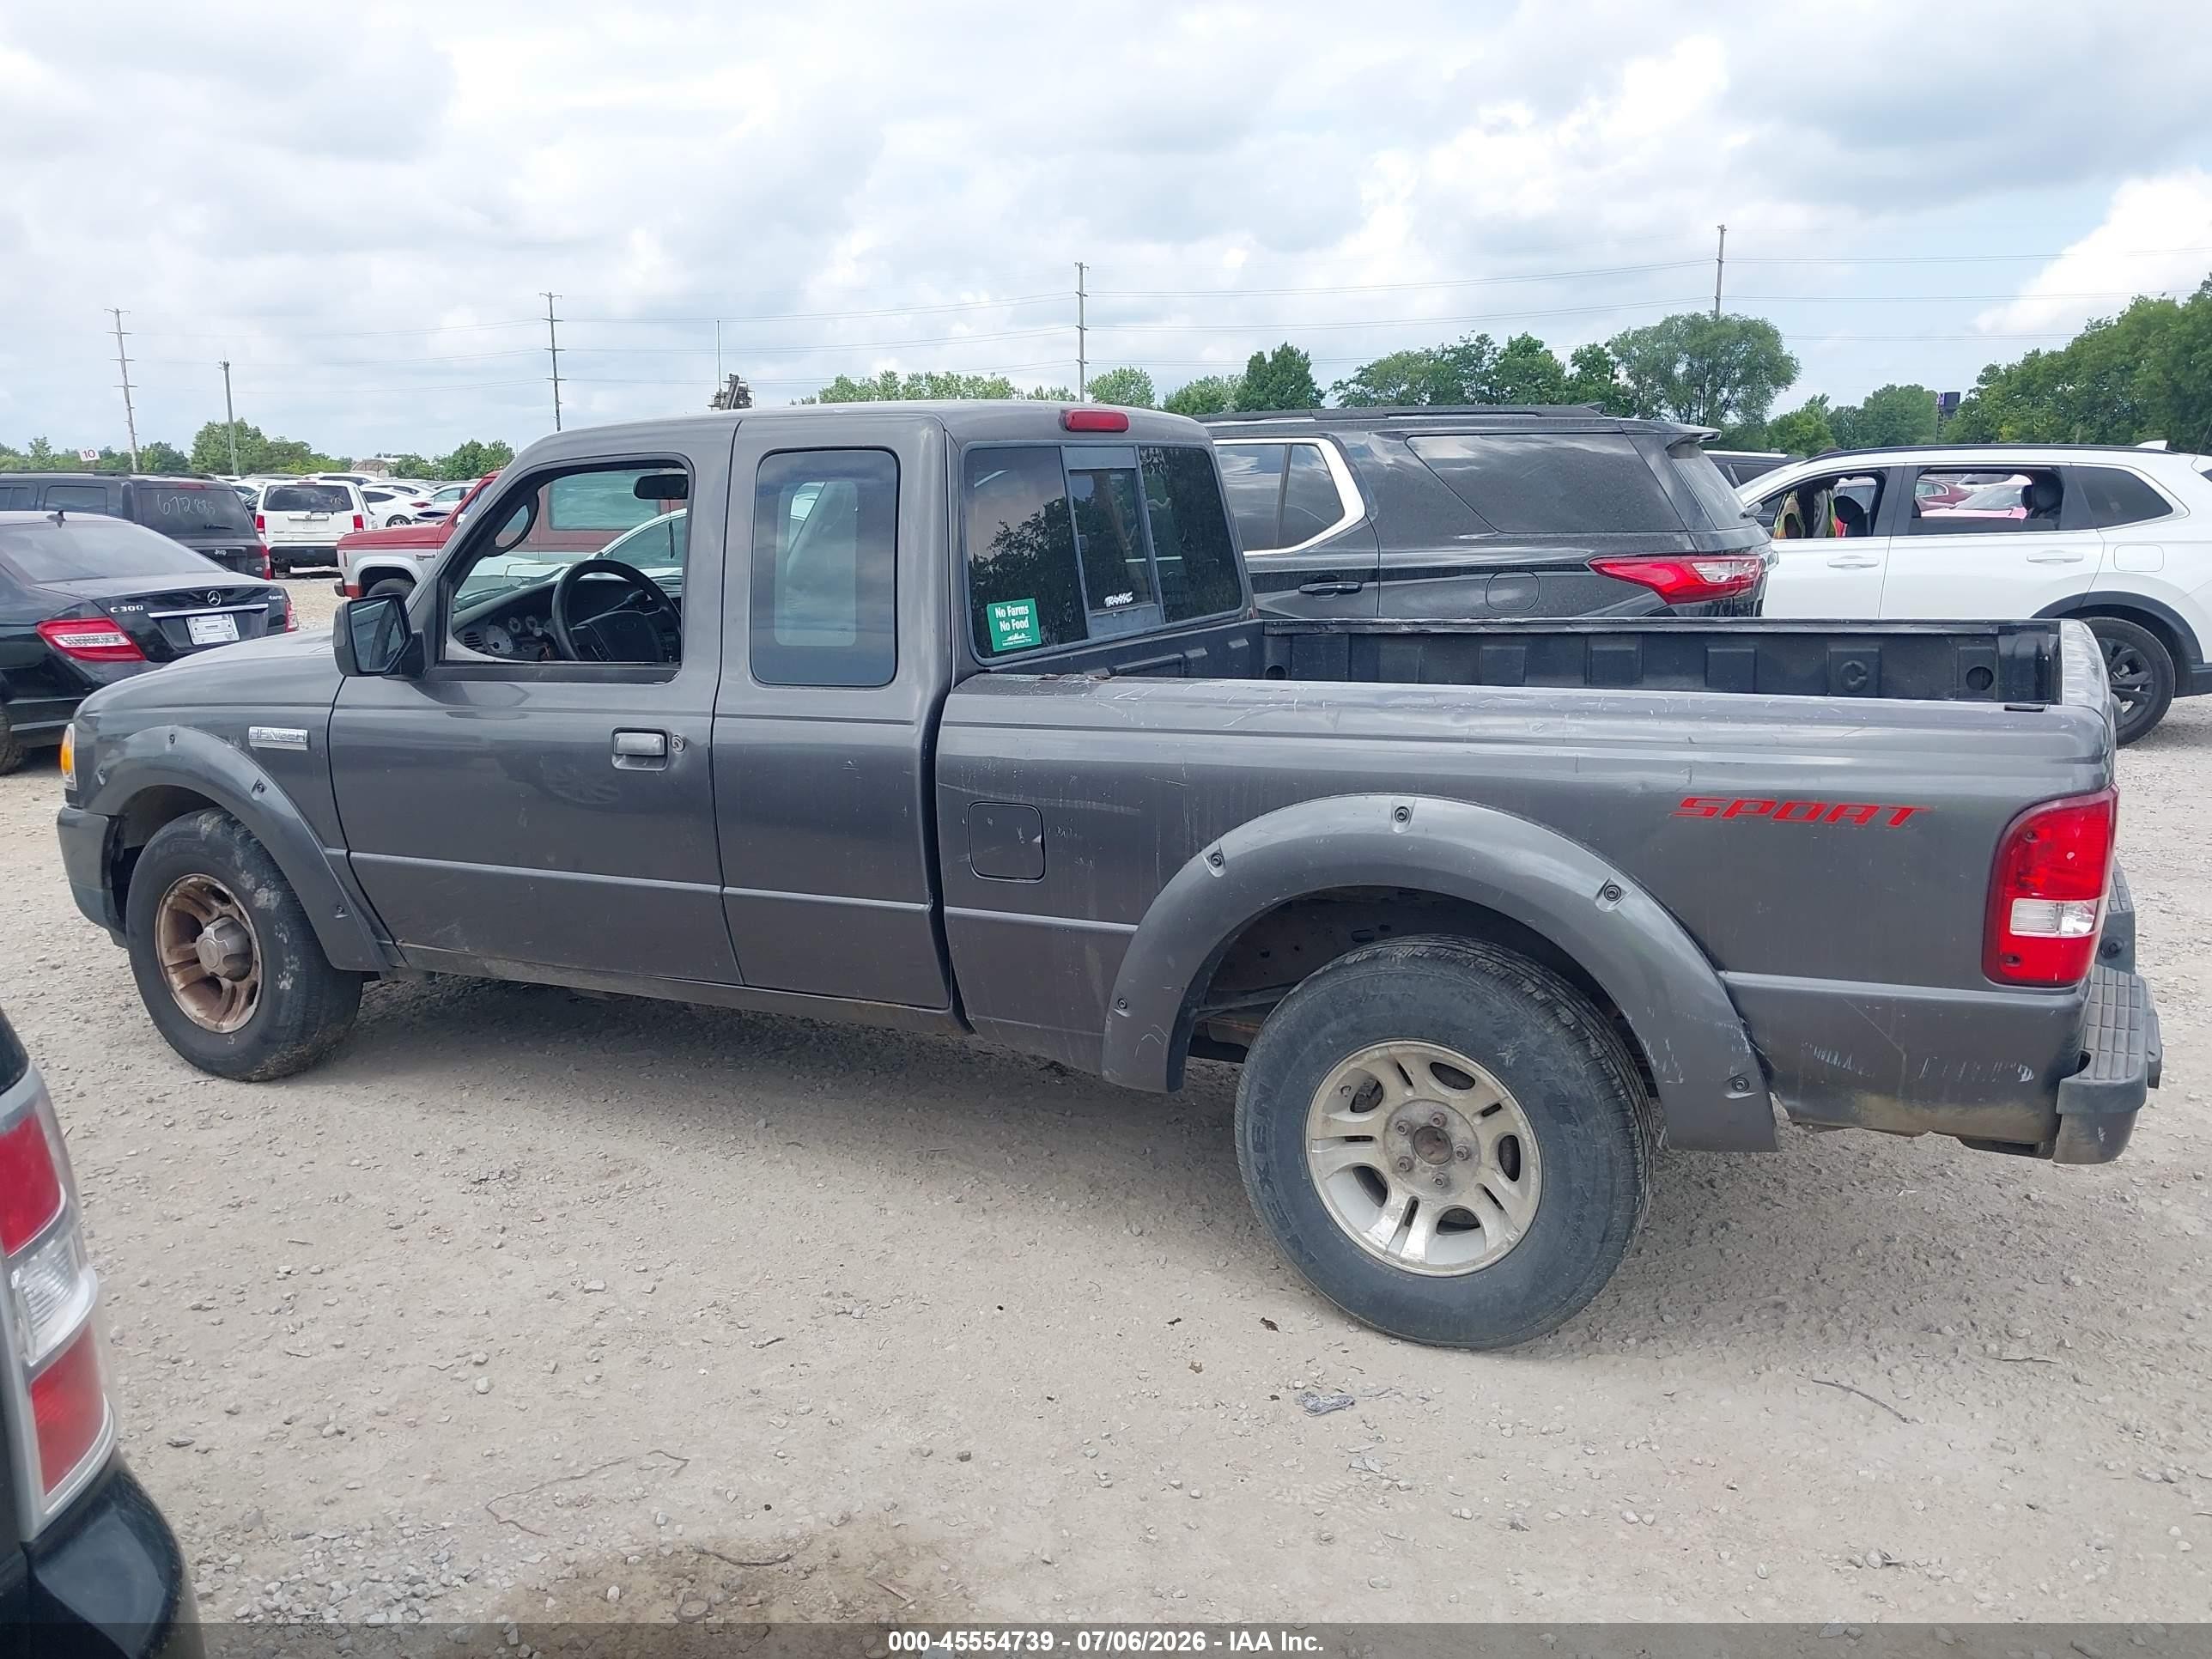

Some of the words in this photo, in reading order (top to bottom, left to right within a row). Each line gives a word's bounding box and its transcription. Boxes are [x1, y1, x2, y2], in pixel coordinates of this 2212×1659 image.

[82, 449, 96, 459] 10
[994, 606, 1006, 618] No
[1006, 605, 1030, 617] Farms
[999, 620, 1011, 633] No
[1011, 616, 1030, 631] Food
[1670, 797, 1932, 828] SPORT
